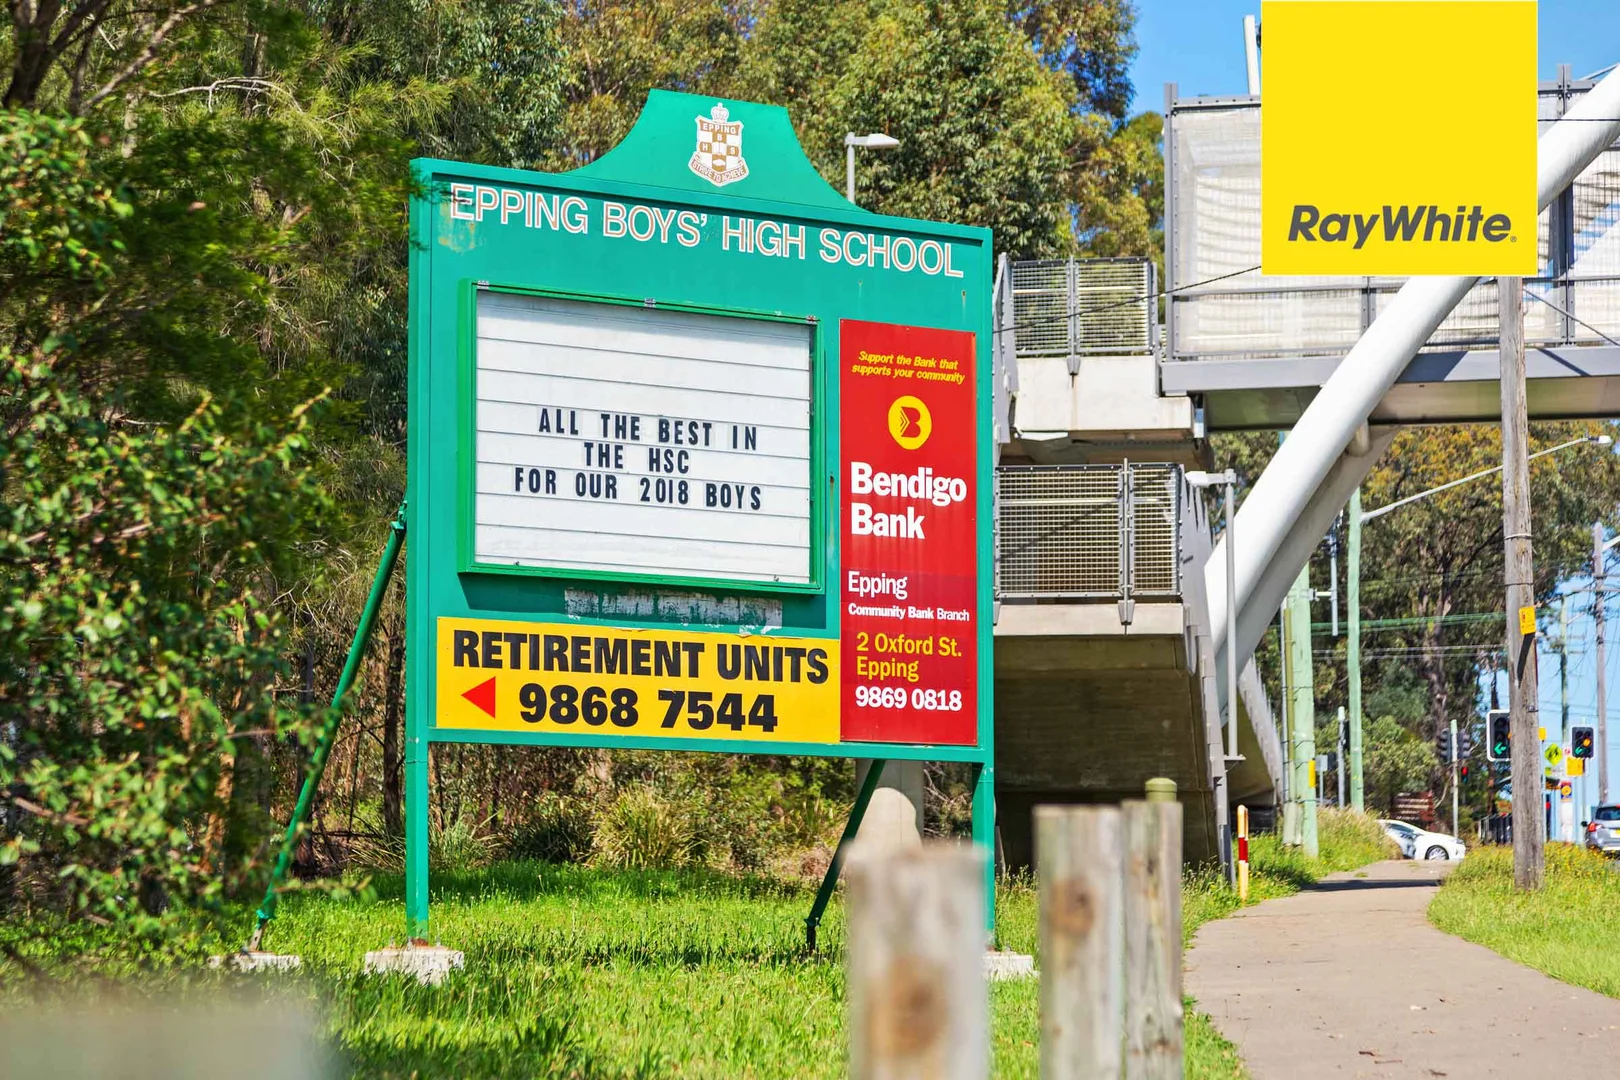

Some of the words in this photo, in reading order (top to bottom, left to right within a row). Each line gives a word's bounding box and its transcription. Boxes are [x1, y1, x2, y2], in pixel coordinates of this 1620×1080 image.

[702, 123, 736, 135] EPPING
[450, 182, 588, 235] EPPING
[602, 201, 708, 248] BOYS'
[722, 215, 806, 260] HIGH
[819, 228, 964, 278] SCHOOL
[852, 364, 892, 376] supports
[893, 368, 914, 379] your
[916, 370, 965, 385] community
[858, 350, 894, 365] Support
[896, 354, 912, 366] the
[914, 356, 937, 368] Bank
[940, 358, 959, 370] that
[538, 408, 579, 436] ALL
[600, 413, 640, 442] THE
[658, 418, 712, 447] BEST
[732, 425, 757, 450] IN
[584, 442, 624, 469] THE
[648, 448, 690, 474] HSC
[514, 467, 557, 495] FOR
[575, 472, 617, 499] OUR
[640, 477, 689, 505] 2018
[706, 483, 762, 511] BOYS
[851, 461, 968, 507] Bendigo
[851, 502, 926, 540] Bank
[848, 570, 908, 600] Epping
[848, 602, 906, 620] Community
[907, 605, 934, 620] Bank
[936, 607, 970, 622] Branch
[453, 629, 705, 679] RETIREMENT
[716, 643, 829, 685] UNITS
[856, 631, 869, 652] 2
[874, 632, 933, 656] Oxford
[938, 636, 962, 657] St.
[856, 656, 920, 683] Epping
[518, 683, 639, 727] 9868
[658, 689, 778, 732] 7544
[855, 685, 907, 709] 9869
[911, 688, 962, 711] 0818
